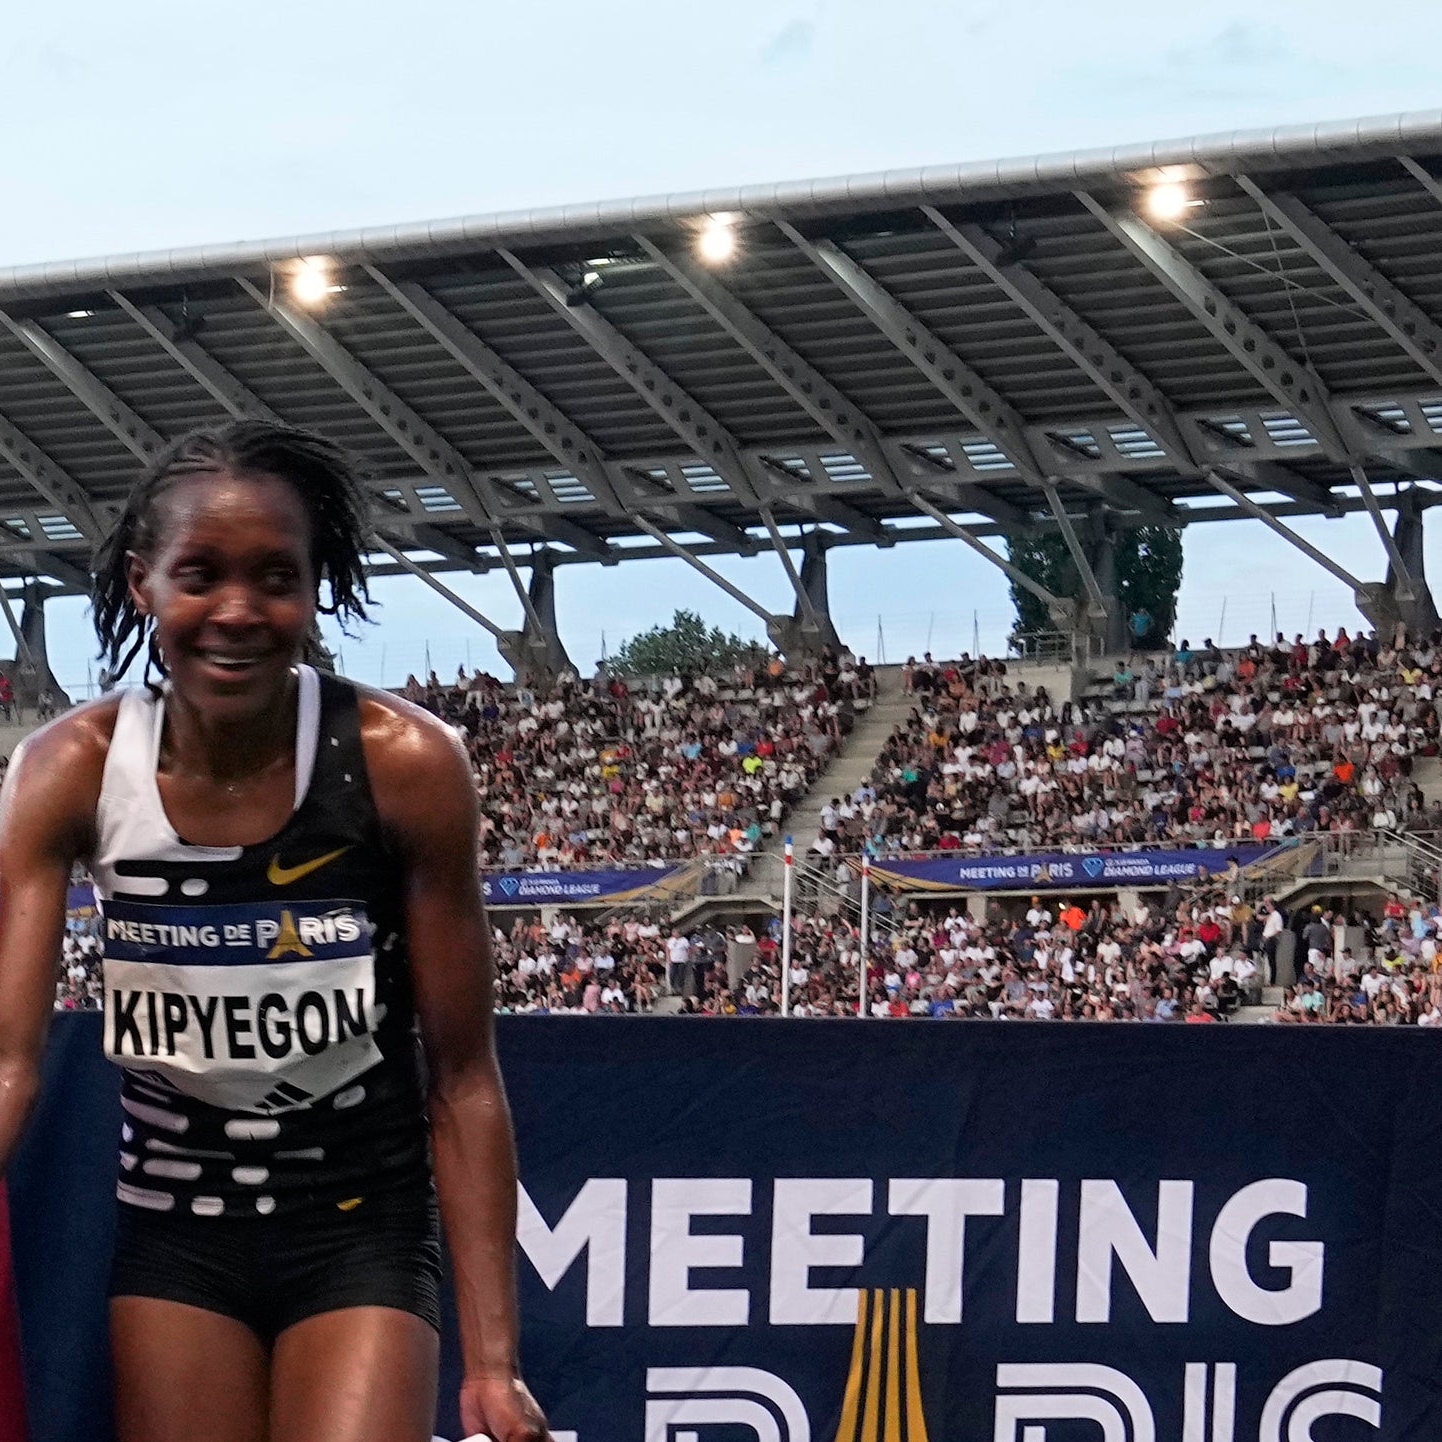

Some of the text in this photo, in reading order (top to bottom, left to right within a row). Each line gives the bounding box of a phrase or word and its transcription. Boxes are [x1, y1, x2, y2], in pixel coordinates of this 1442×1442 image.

[959, 866, 1016, 880] MEETING
[1103, 863, 1196, 877] DIAMOND LEAGUE
[106, 910, 362, 959] MEETING DE PARIS
[112, 988, 368, 1060] KIPYEGON
[516, 1177, 1325, 1328] MEETING
